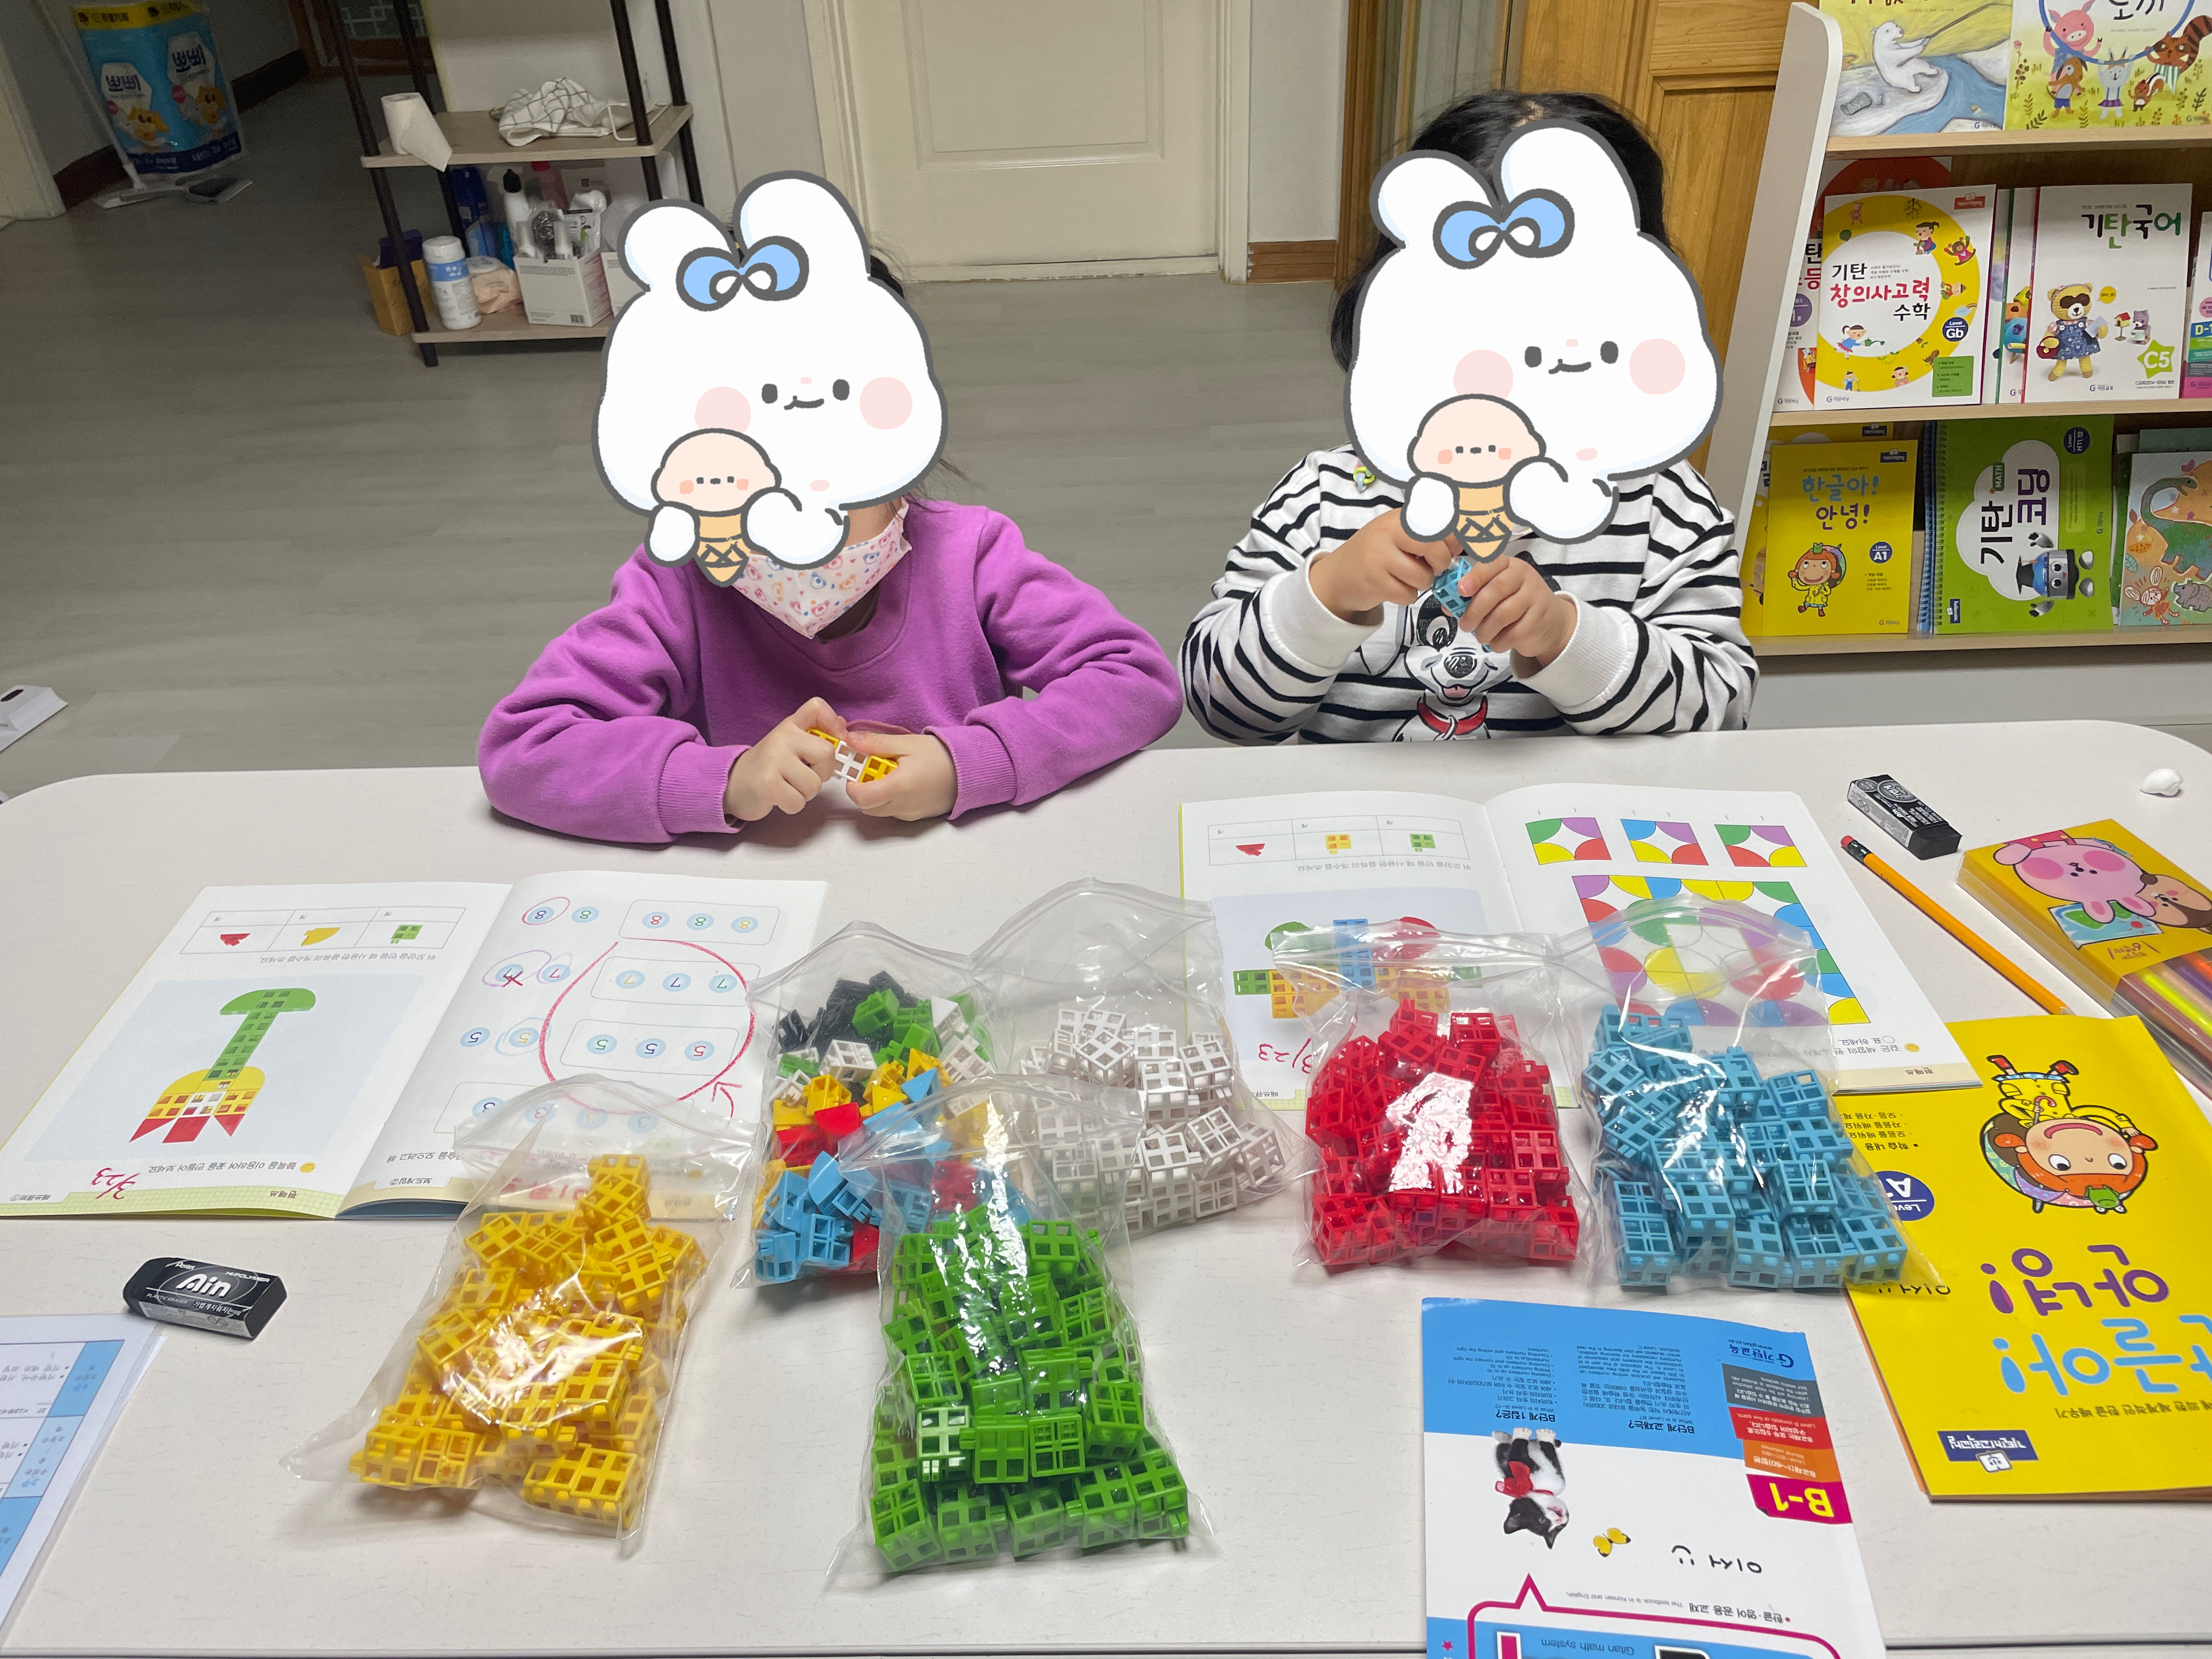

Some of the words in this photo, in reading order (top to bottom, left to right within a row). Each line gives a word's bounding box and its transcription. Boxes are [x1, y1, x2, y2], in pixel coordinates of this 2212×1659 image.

[2081, 204, 2181, 249] 기탄국어
[1805, 244, 1822, 264] 탄
[1832, 263, 1867, 280] 기탄
[1830, 277, 1929, 308] 창의사고력
[1893, 303, 1931, 321] 수학
[1946, 329, 1963, 340] Gb
[2144, 351, 2170, 368] C5
[1802, 474, 1879, 503] 한글아!
[2017, 469, 2050, 526] 코딩
[1816, 504, 1870, 530] 안녕!
[1980, 501, 2013, 565] 기탄
[1874, 551, 1887, 561] A1
[534, 911, 546, 922] 8
[579, 910, 592, 921] 8
[650, 915, 662, 926] 8
[694, 916, 707, 928] 8
[739, 919, 751, 930] 8
[549, 968, 561, 979] 7
[623, 973, 635, 985] 7
[669, 977, 681, 989] 7
[716, 978, 727, 990] 7
[469, 1031, 482, 1043] 5
[517, 1032, 533, 1044] 5
[594, 1039, 609, 1051] 5
[644, 1043, 657, 1055] 5
[692, 1045, 707, 1058] 5
[1259, 1037, 1312, 1074] 3/23
[482, 1102, 496, 1115] 3
[1864, 1143, 1886, 1151] 내용
[1888, 1142, 1909, 1150] 학습
[386, 1155, 397, 1163] 해
[399, 1153, 436, 1161] 모으려고
[177, 1163, 205, 1172] 만들어
[228, 1161, 265, 1170] 이용하여
[91, 1167, 141, 1200] 3/23
[176, 1274, 231, 1297] Ain
[1980, 1244, 2170, 1317] 안녕!
[1899, 1283, 1950, 1295] 이서
[1729, 1344, 1774, 1361] 기탄교육
[1496, 1409, 1525, 1420] 1집은?
[1530, 1413, 1555, 1422] B단계
[2054, 1407, 2094, 1419] 배우기
[2094, 1406, 2120, 1418] 한글
[1628, 1420, 1663, 1431] 교재는?
[1668, 1423, 1695, 1434] B단계
[1747, 1427, 1771, 1436] 5집으로
[1788, 1433, 1813, 1443] B교재는
[1947, 1435, 2027, 1449] 기탄사고력교실
[1769, 1483, 1835, 1517] B-1
[1707, 1555, 1763, 1574] 이서
[1689, 1602, 1709, 1613] 교재
[1713, 1605, 1733, 1617] 공용
[1541, 1638, 1577, 1650] system
[1578, 1643, 1605, 1654] math
[1607, 1644, 1635, 1656] Gitan
